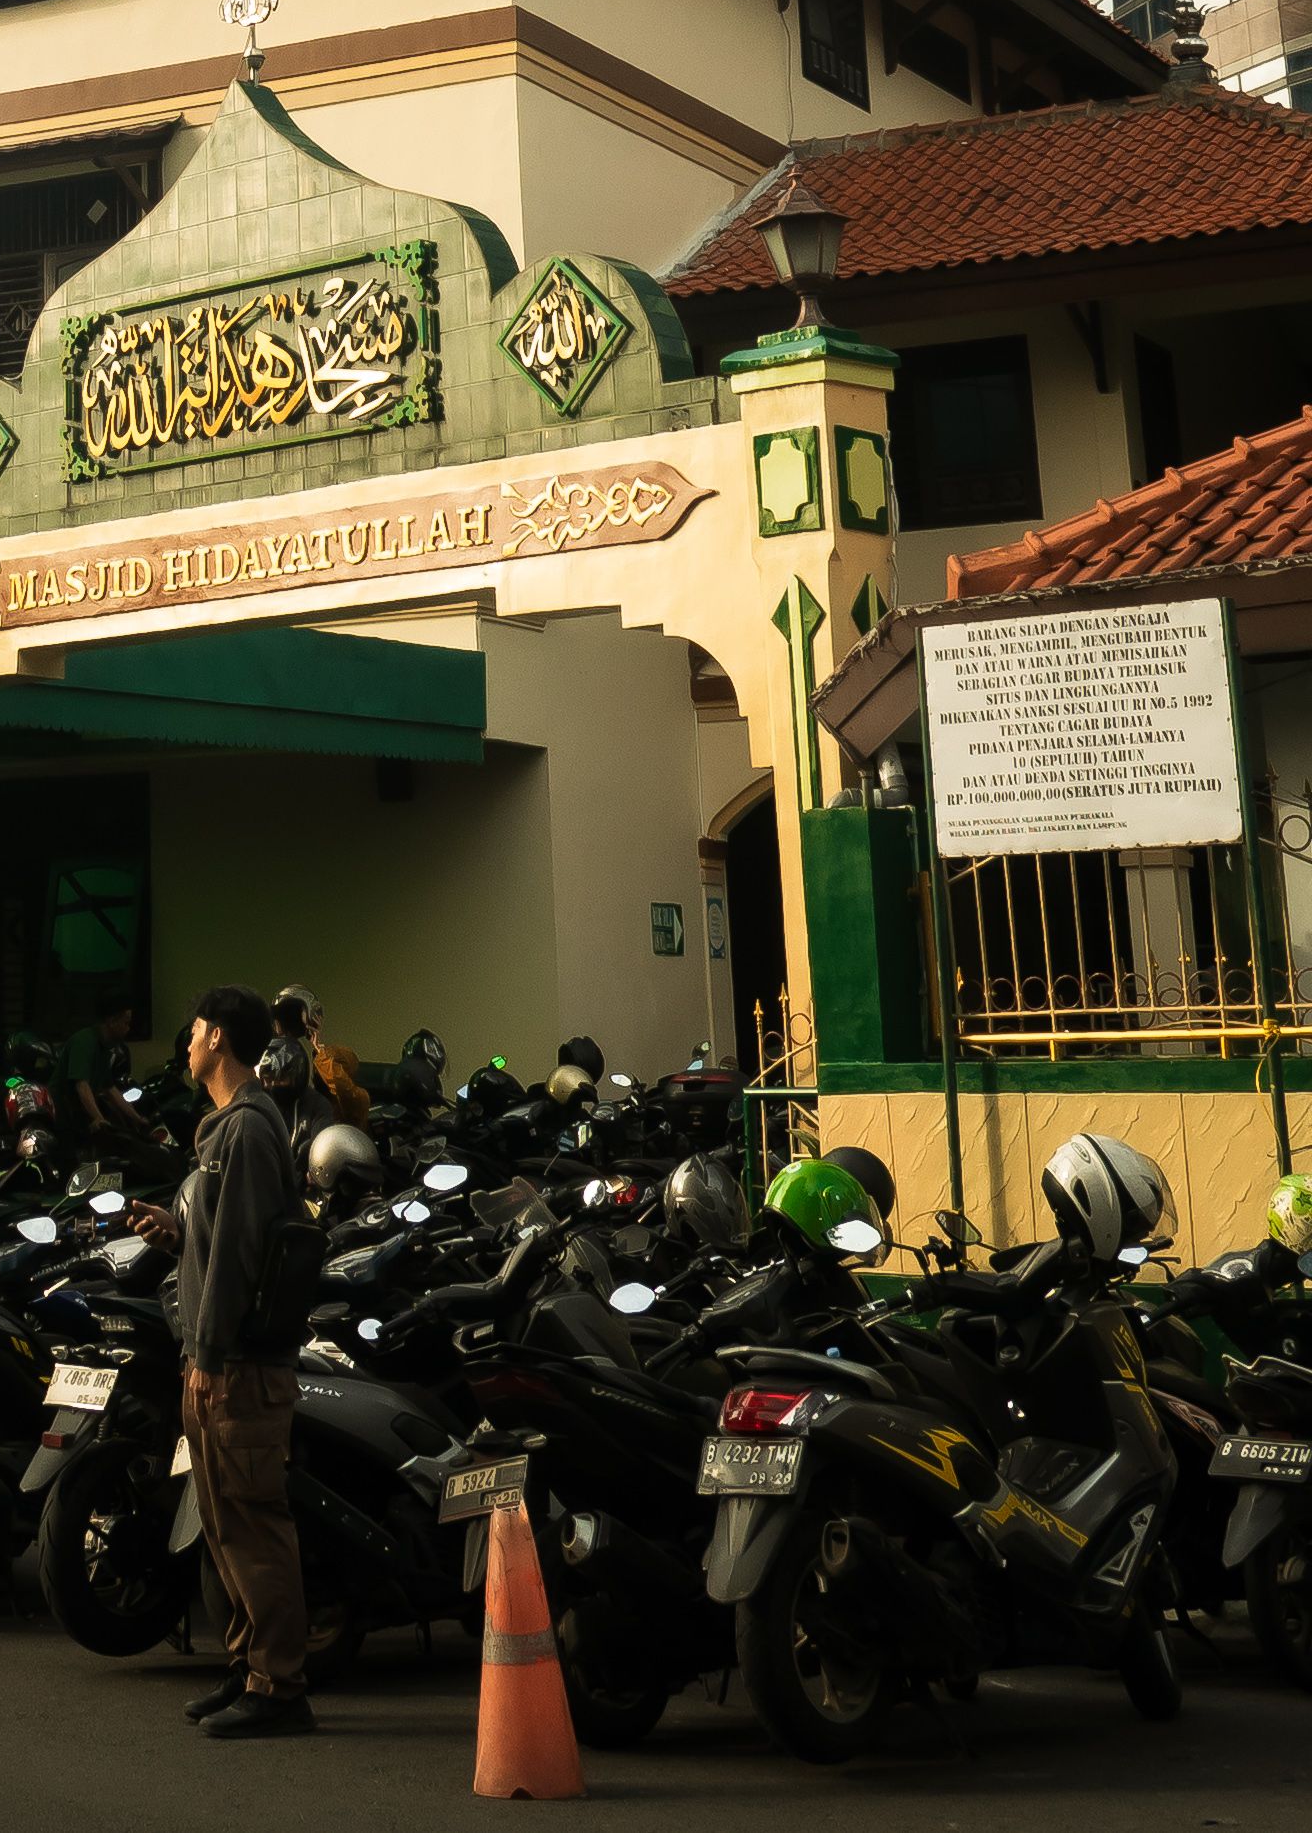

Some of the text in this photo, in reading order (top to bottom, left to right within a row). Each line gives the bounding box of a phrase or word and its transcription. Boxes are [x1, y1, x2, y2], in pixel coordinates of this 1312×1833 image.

[8, 504, 494, 612] MASJID HIDAYATULLAH
[968, 611, 1170, 643] BARANG SIAPA DENGAN SENGAJA
[934, 625, 1208, 662] MERUSAK, MENGAMBIL, MENGUBAH BENTUK
[955, 644, 1188, 676] DAN ATAU WARNA ATAU MEMISAHKAN
[957, 661, 1188, 692] SEBAGIAN CAGAR BUDAYA TERMASUK
[986, 681, 1159, 706] SITUS DAN LINGKUNGANNYA
[940, 708, 1013, 725] DIKENAKAN
[1014, 704, 1059, 719] SANKSI
[1063, 700, 1108, 716] SESUAI
[1112, 699, 1128, 713] UU
[1133, 697, 1147, 711] RI
[1183, 694, 1213, 708] 1992
[999, 715, 1153, 737] TENTANG CAGAR BUDAYA
[969, 730, 1186, 756] PIDANA PENJARA SELAMA-LAMANYA
[1013, 749, 1145, 769] 10 (SEPULUH) TAHUN
[963, 762, 1195, 788] DAN ATAU DENDA SETINGGI TINGGINYA
[1128, 782, 1161, 795] JUTA
[1164, 778, 1222, 794] RUPIAH)
[706, 1444, 717, 1463] B
[724, 1443, 761, 1464] 4232
[1221, 1441, 1233, 1456] B
[1240, 1443, 1278, 1460] 6605
[448, 1477, 457, 1498] B
